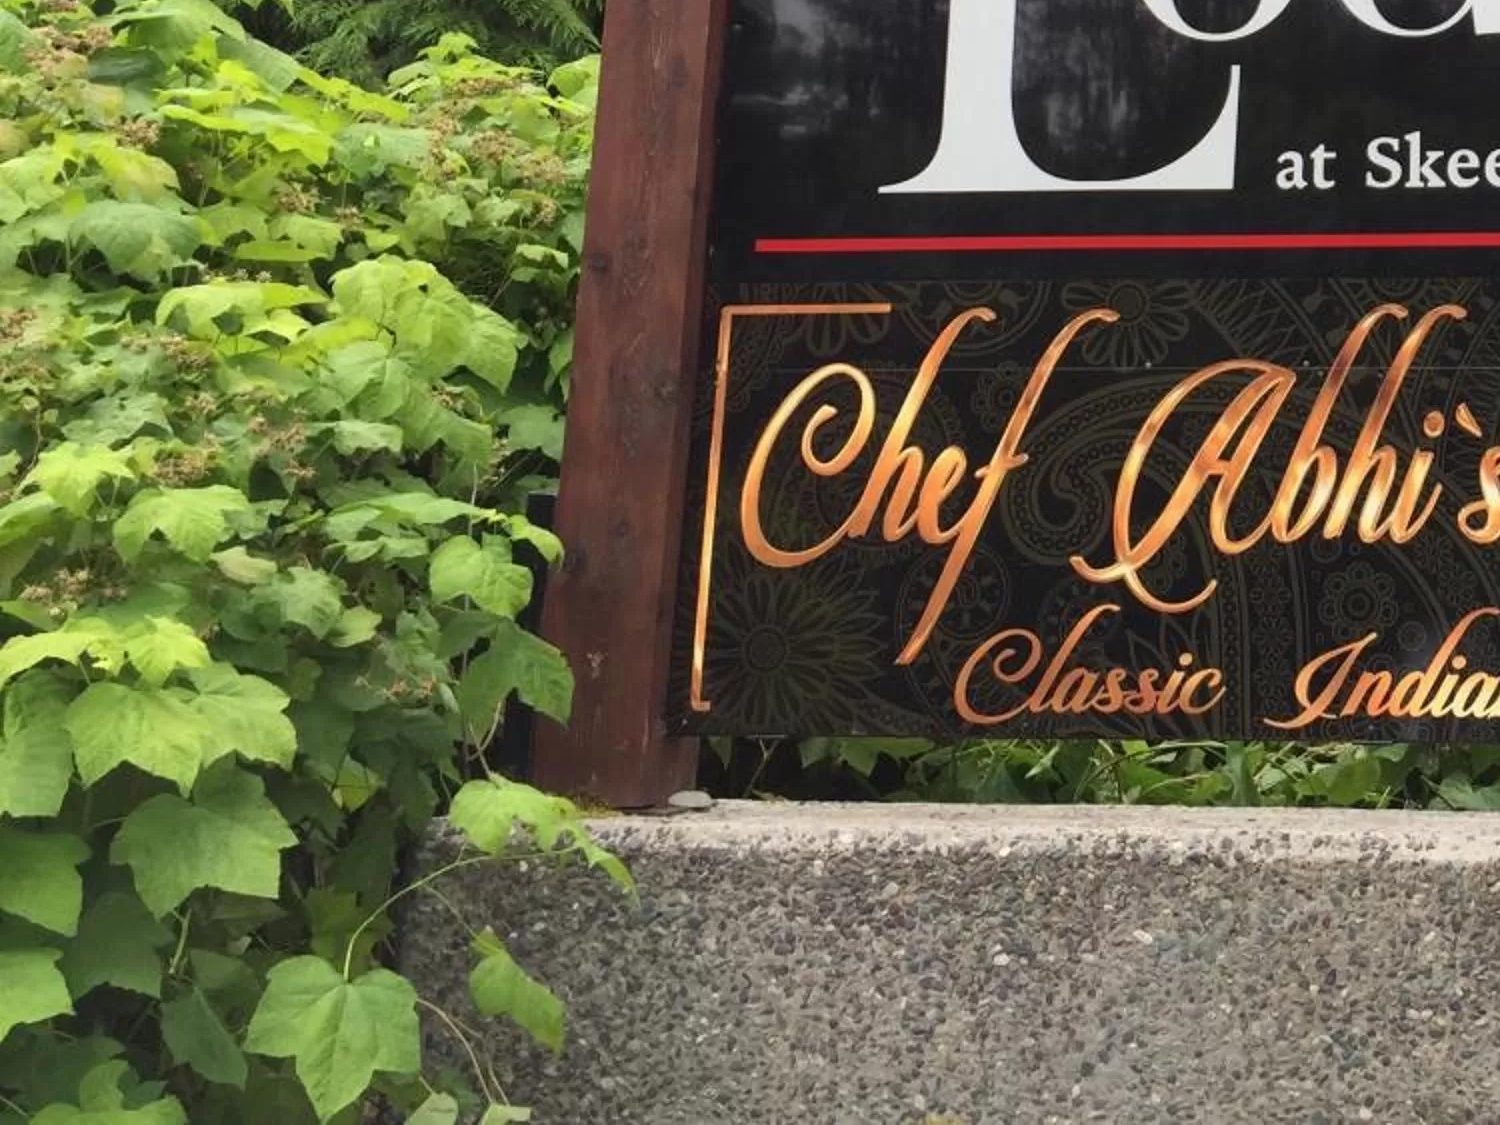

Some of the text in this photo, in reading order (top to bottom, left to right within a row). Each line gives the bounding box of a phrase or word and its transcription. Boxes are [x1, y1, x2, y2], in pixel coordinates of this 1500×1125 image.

[1275, 142, 1338, 191] at
[739, 305, 1121, 667] Chef
[952, 602, 1228, 727] Classic
